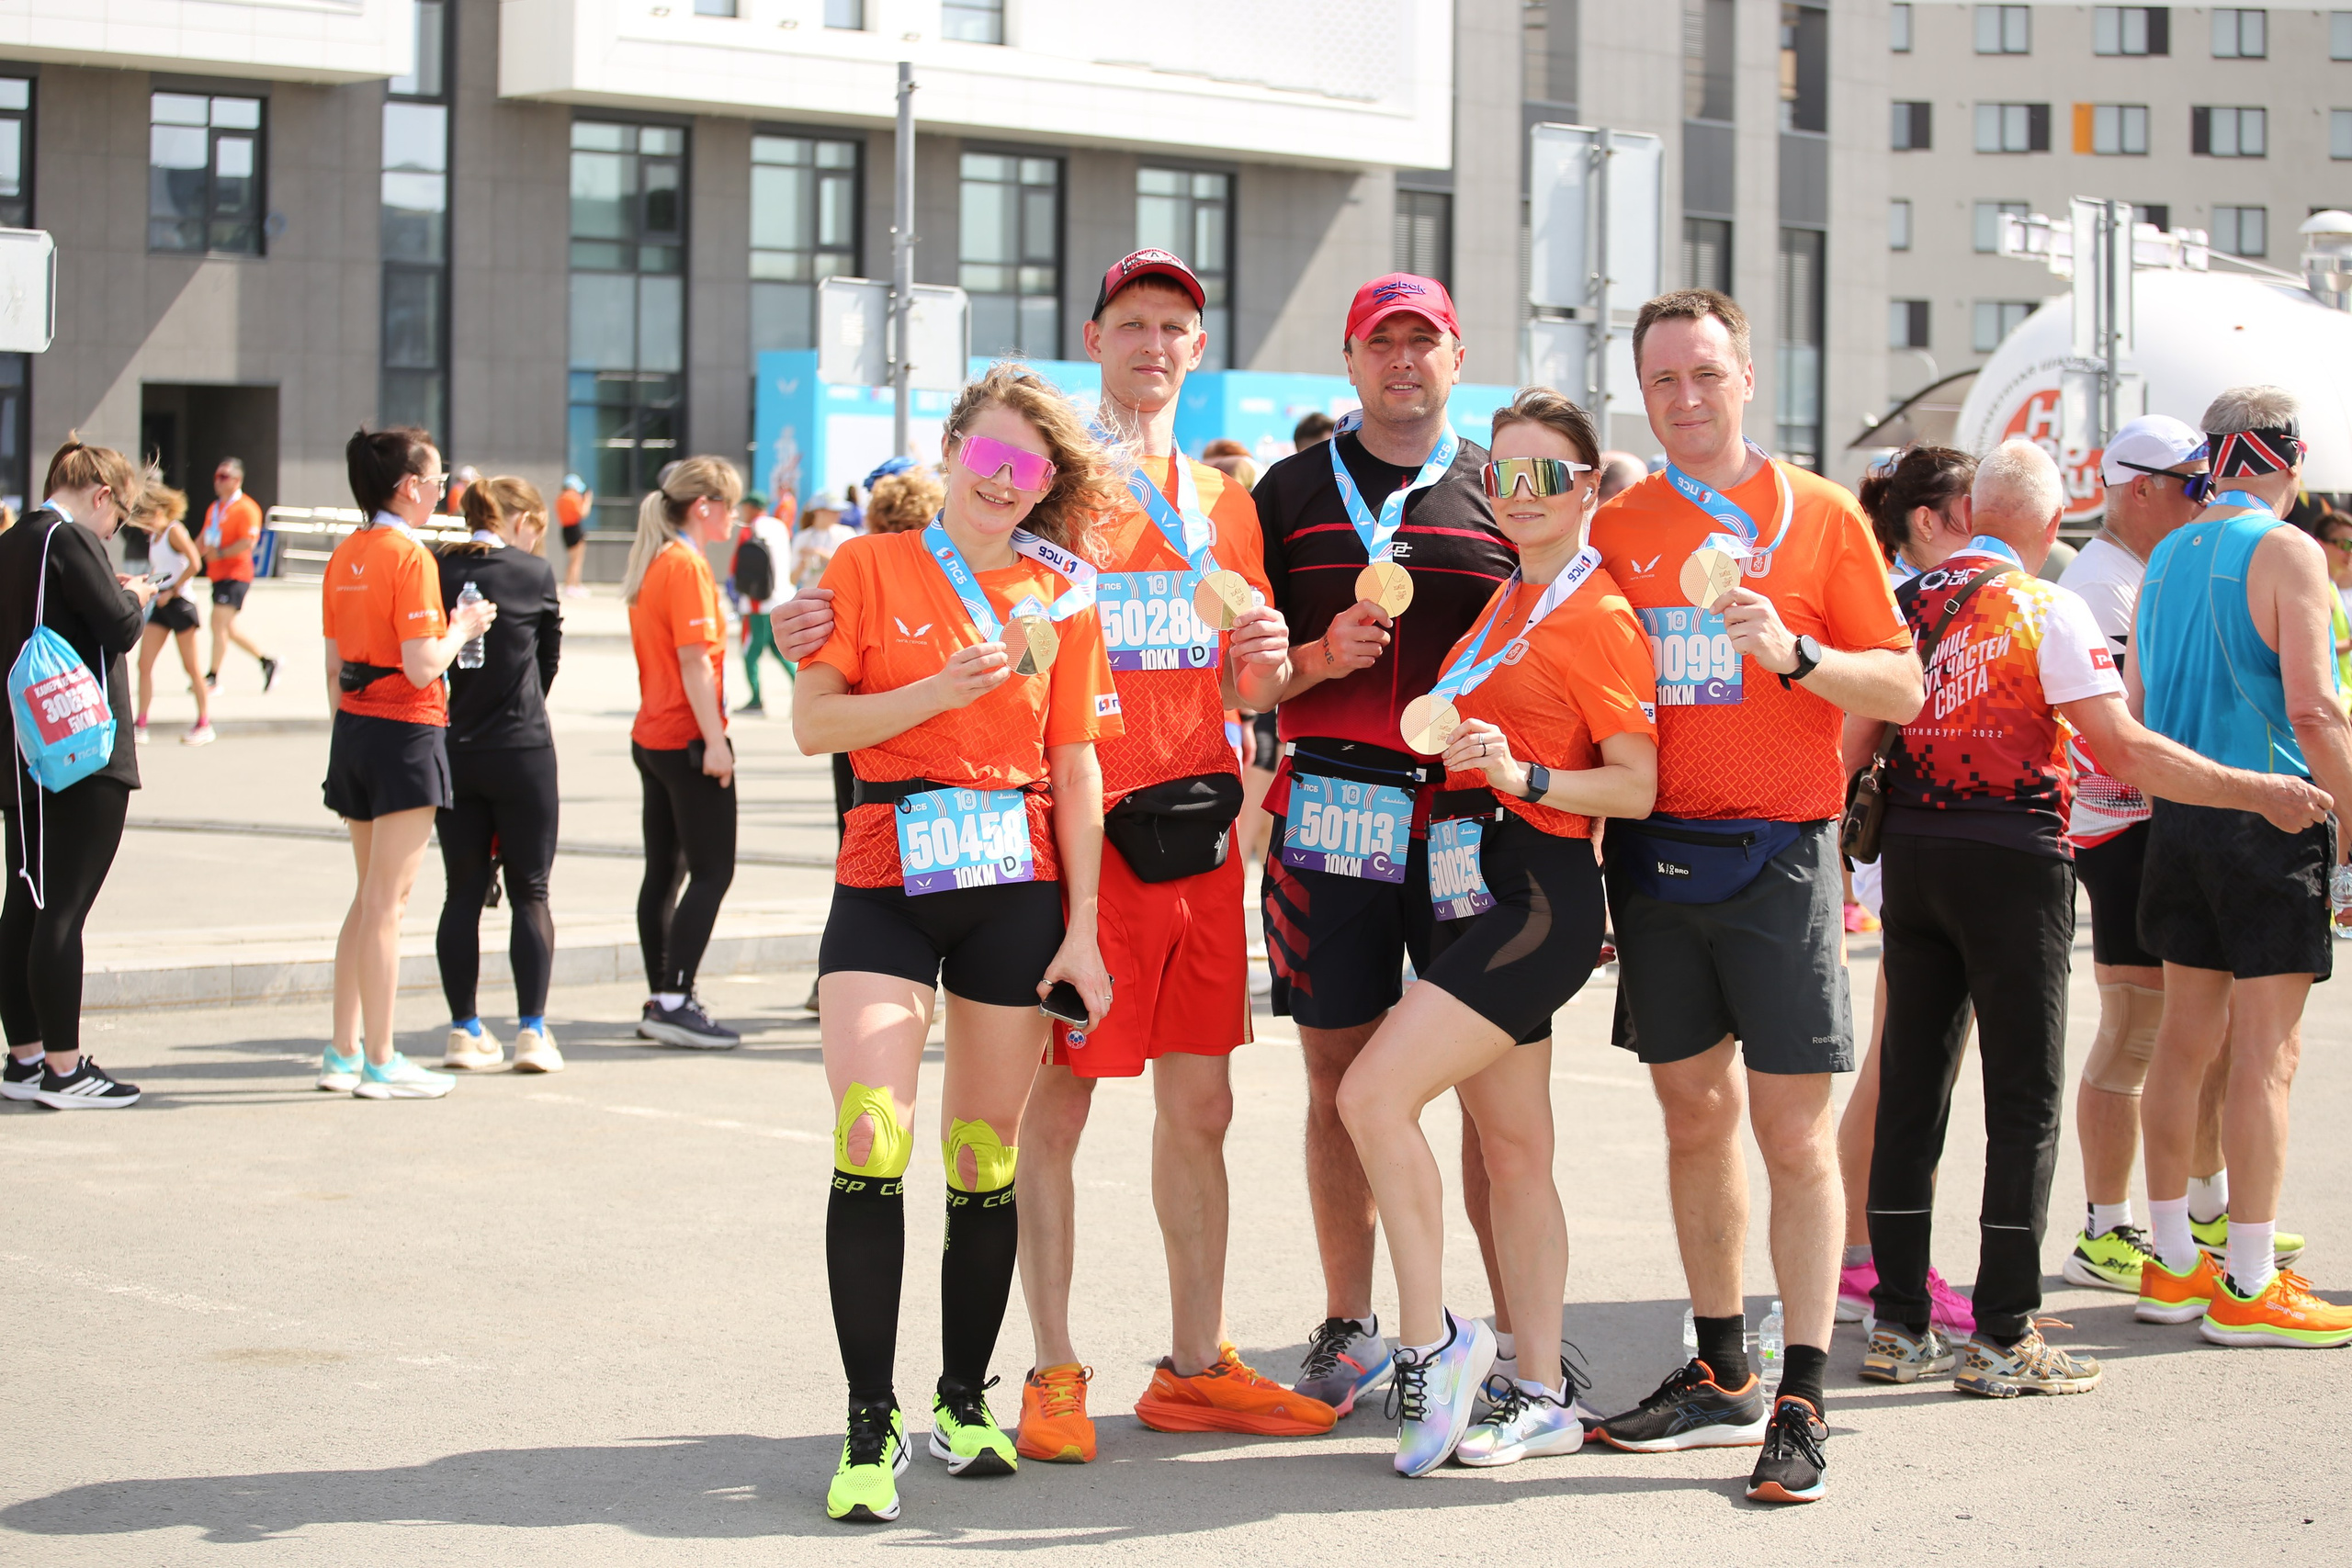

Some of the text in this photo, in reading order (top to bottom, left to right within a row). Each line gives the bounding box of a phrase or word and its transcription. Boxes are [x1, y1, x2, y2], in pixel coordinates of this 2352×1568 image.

[1373, 281, 1426, 297] Reebok
[1432, 443, 1452, 468] ПСБ
[1678, 477, 1699, 496] ПСБ
[1038, 546, 1064, 566] ПСБ
[946, 559, 967, 585] ПСБ
[1567, 563, 1586, 582] ПСБ
[1104, 582, 1122, 591] ПСБ
[1146, 574, 1168, 596] 10
[1666, 610, 1687, 632] 10
[1192, 646, 1205, 660] D
[1649, 634, 1736, 682] 0099
[1946, 628, 2011, 680] ЧАСТЕЙ
[1708, 682, 1724, 698] C
[1935, 663, 1988, 720] СВЕТА
[1899, 728, 2003, 739] ТЕРИНБУРГ 2022
[77, 747, 98, 759] ПСБ
[1304, 784, 1318, 793] ПСБ
[1340, 784, 1361, 806] 10
[911, 803, 928, 813] ПСБ
[954, 789, 977, 812] 10
[1299, 801, 1395, 857] 50113
[1442, 825, 1452, 846] 10
[906, 809, 1024, 870] 50458
[1003, 856, 1016, 872] D
[1373, 855, 1387, 871] C
[1430, 845, 1481, 898] 50025
[1470, 892, 1480, 907] C
[880, 1180, 904, 1196] ce
[946, 1193, 969, 1208] ep
[2265, 1301, 2306, 1321] SPINE
